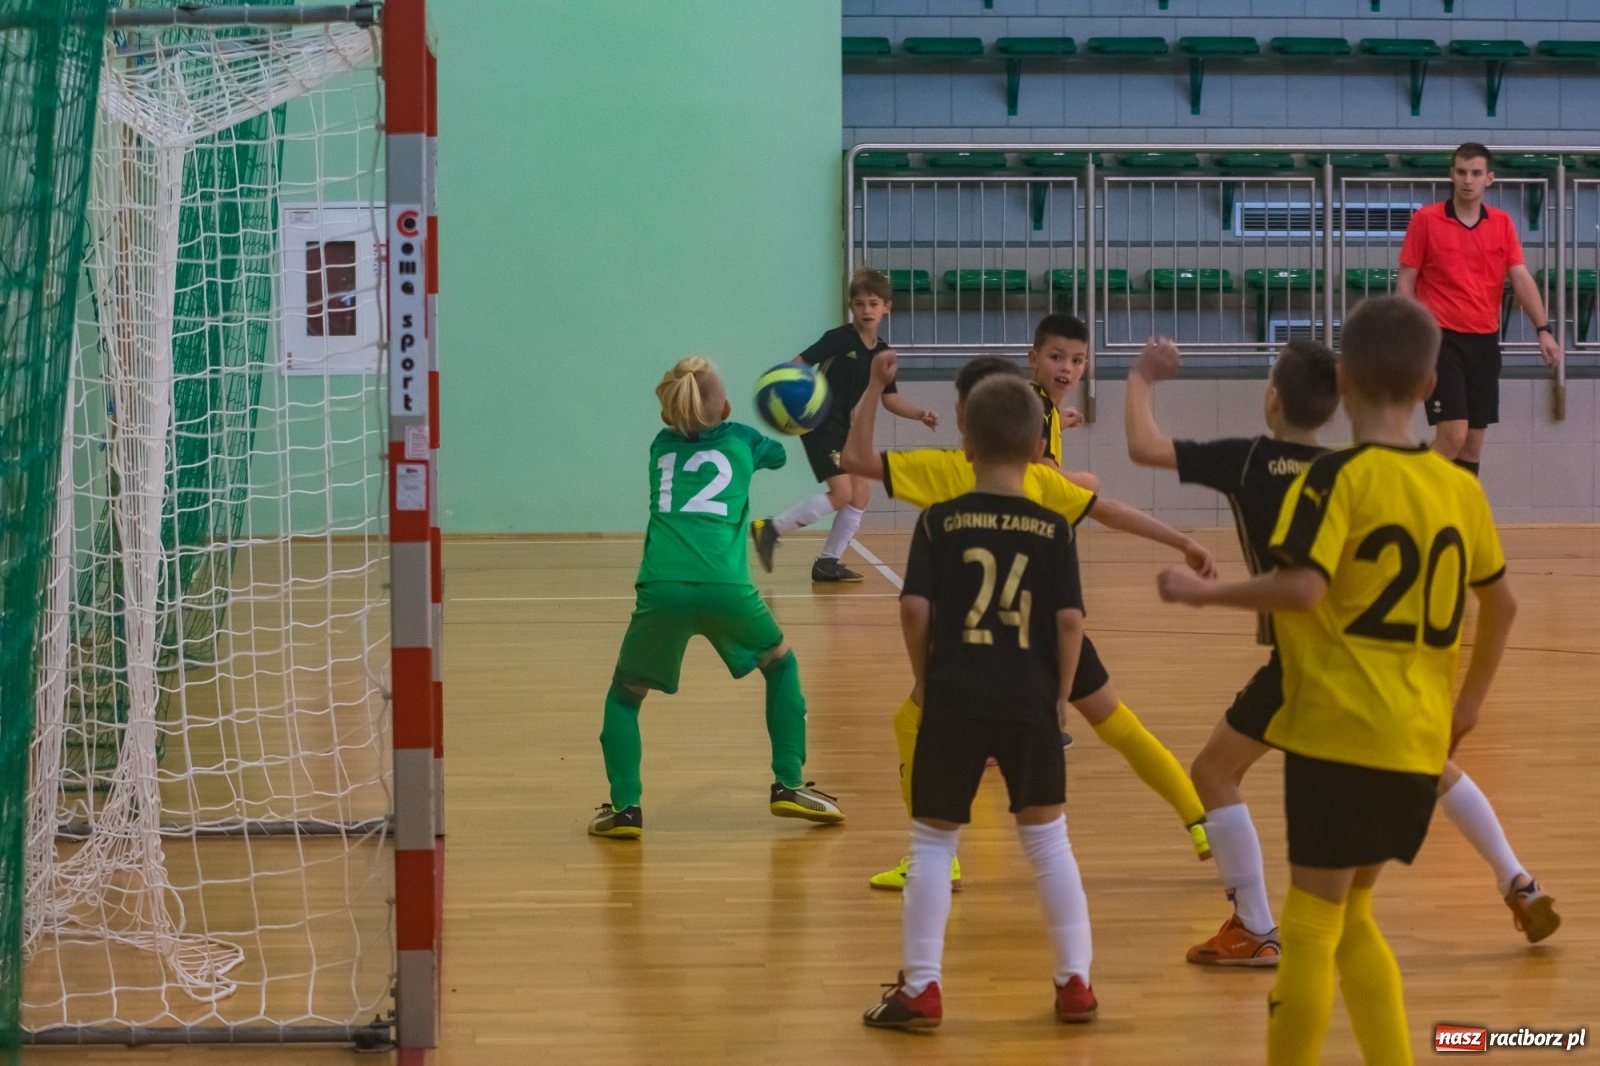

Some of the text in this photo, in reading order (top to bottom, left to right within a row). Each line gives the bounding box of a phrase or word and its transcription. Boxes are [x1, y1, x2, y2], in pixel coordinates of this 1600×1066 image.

[401, 314, 415, 411] sport
[657, 449, 733, 516] 12
[943, 511, 1056, 539] GÓRNIK ZABRZE
[962, 547, 1032, 650] 24
[1343, 524, 1467, 650] 20
